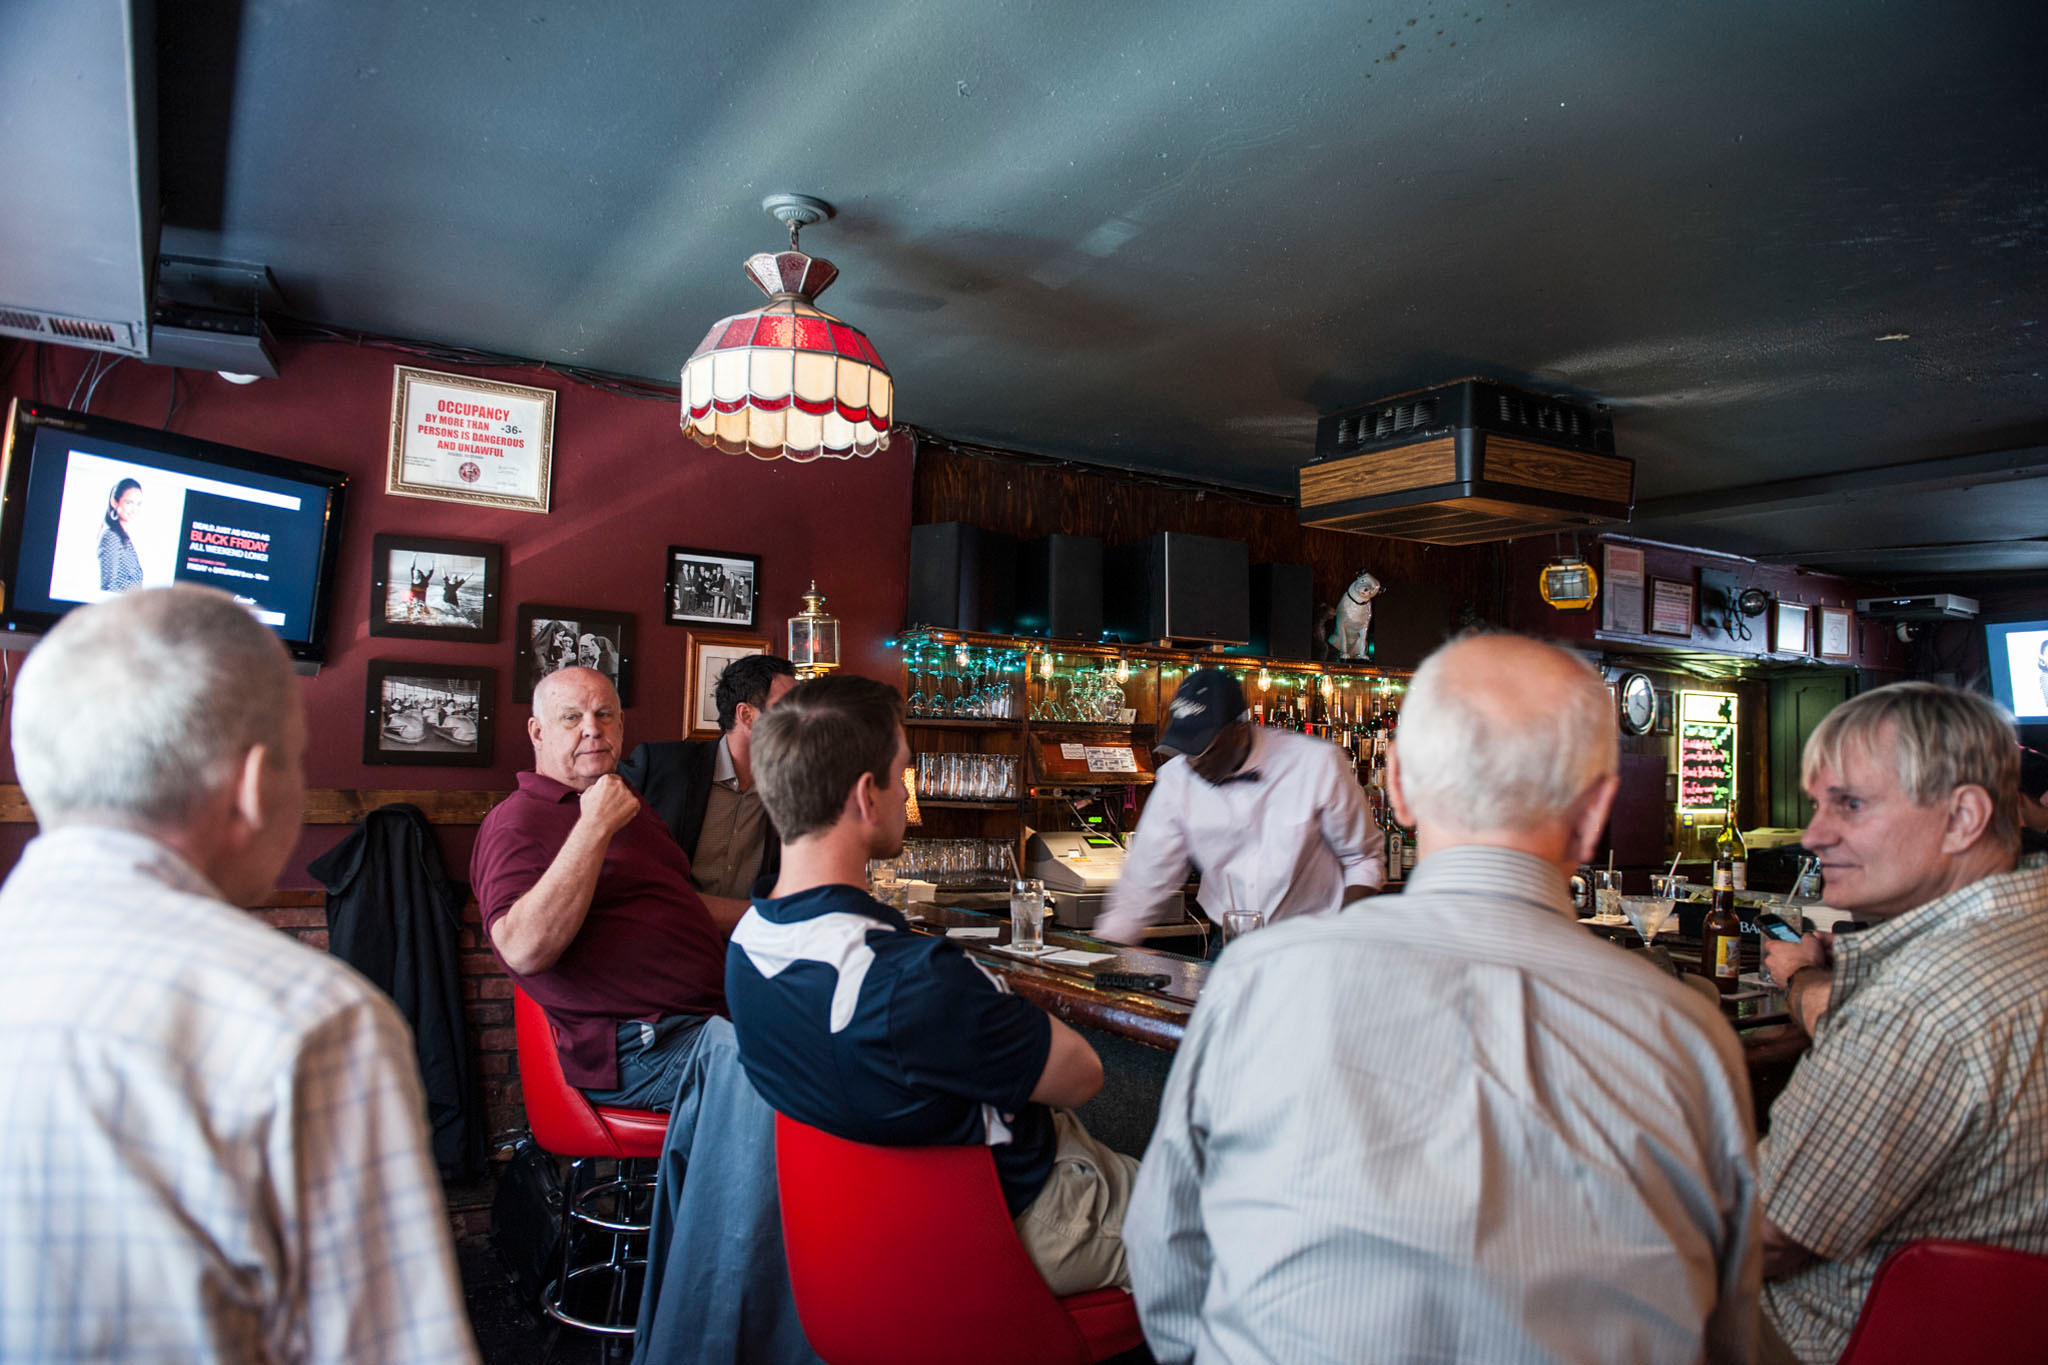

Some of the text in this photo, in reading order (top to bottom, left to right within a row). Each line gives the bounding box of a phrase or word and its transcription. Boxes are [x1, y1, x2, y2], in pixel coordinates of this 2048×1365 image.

[437, 399, 510, 422] OCCUPANCY
[425, 413, 437, 423] BY
[438, 414, 464, 428] MORE
[467, 419, 490, 431] THAN
[418, 424, 525, 449] PERSONS IS DANGEROUS
[437, 440, 456, 451] AND
[458, 442, 504, 458] UNLAWFUL
[189, 542, 205, 552] ALL
[190, 530, 269, 552] BLACK FRIDAY
